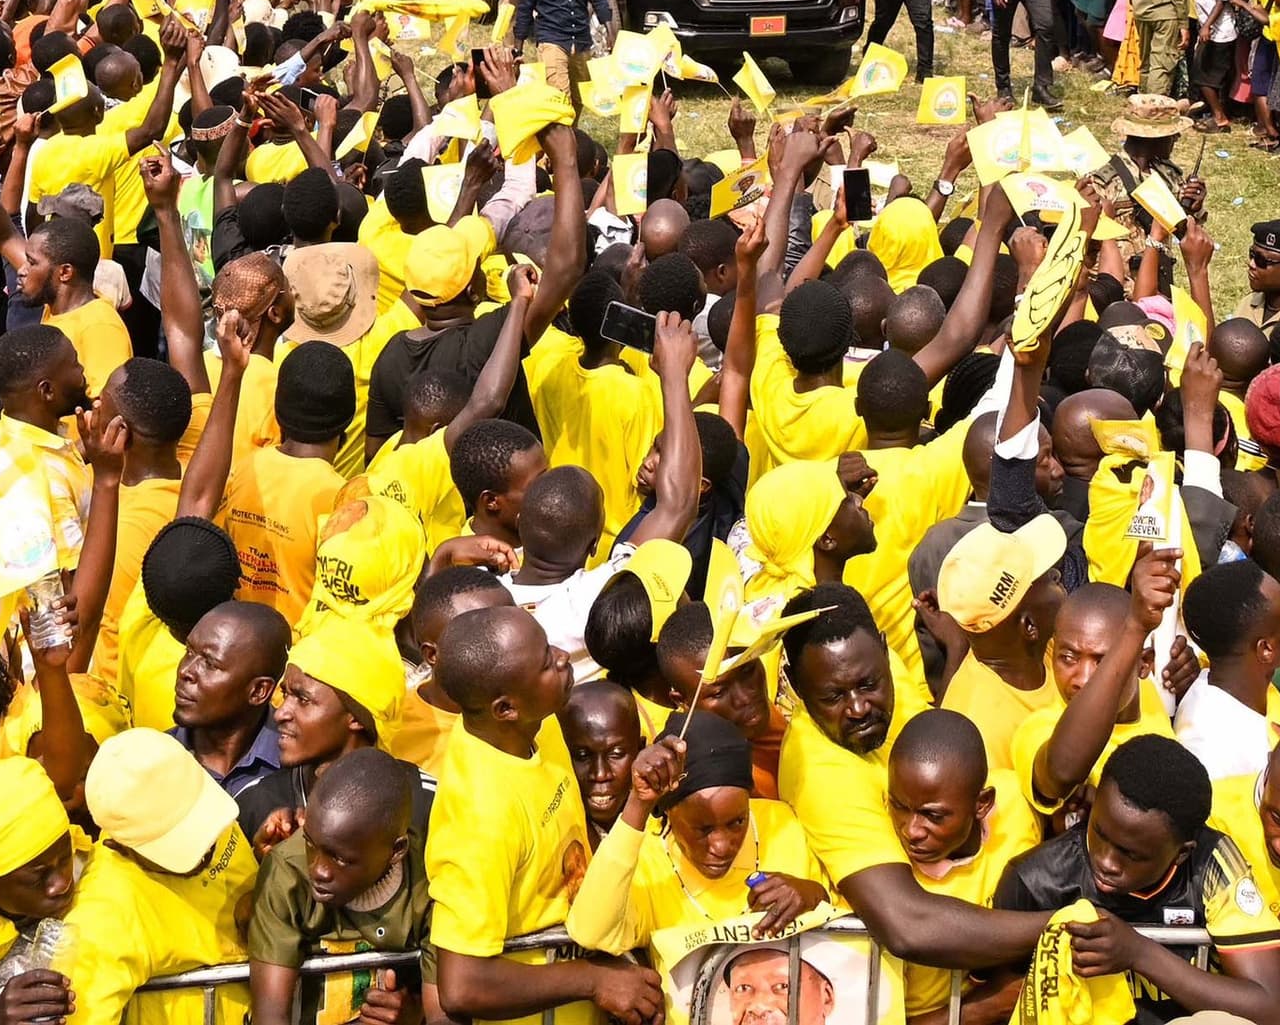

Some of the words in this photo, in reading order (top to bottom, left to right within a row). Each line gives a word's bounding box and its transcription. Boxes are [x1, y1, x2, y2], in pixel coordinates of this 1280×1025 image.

[1127, 525, 1160, 536] USEVENI
[1132, 515, 1156, 525] OWERI
[989, 571, 1015, 606] NRM
[1025, 985, 1035, 1017] GAINS
